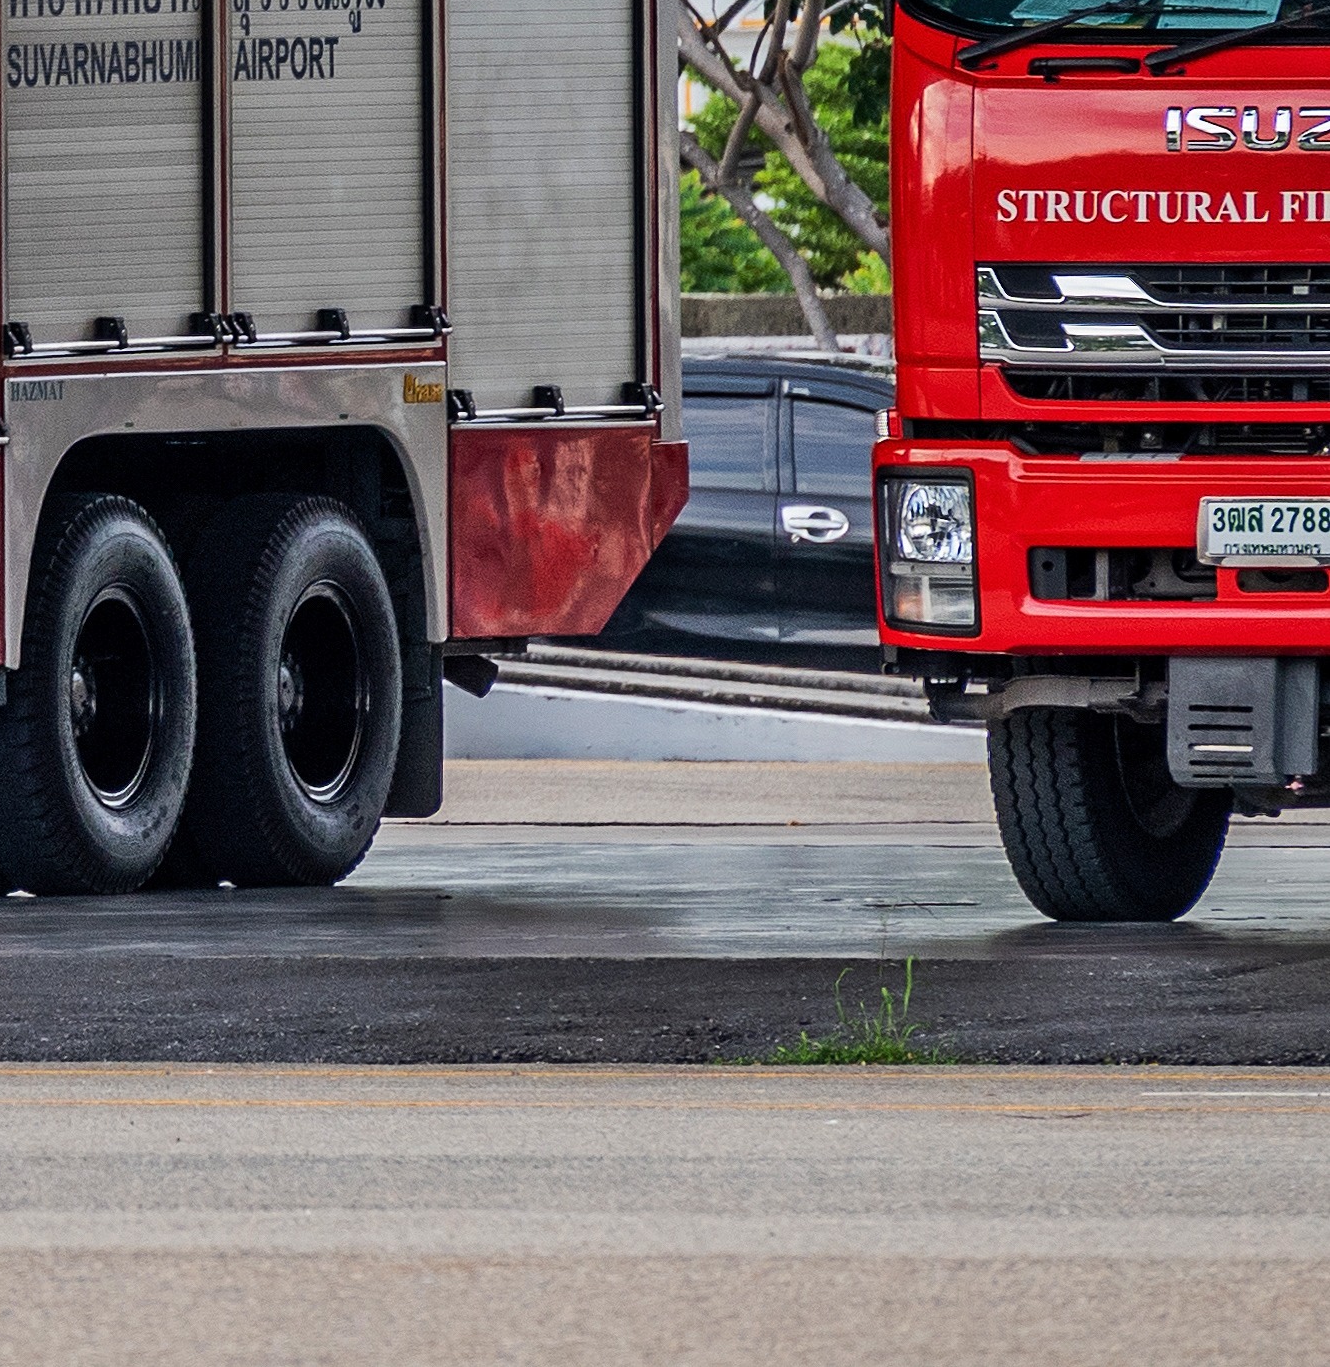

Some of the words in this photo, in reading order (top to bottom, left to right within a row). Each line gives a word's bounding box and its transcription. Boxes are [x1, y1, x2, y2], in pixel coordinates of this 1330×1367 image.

[6, 40, 201, 89] SUVARNABHUMI
[233, 35, 339, 83] AIRPORT
[996, 189, 1269, 224] STRUCTURAL
[10, 379, 64, 401] HAZMAT
[1271, 506, 1330, 533] 2788
[1224, 543, 1321, 555] กรงเทพมหานคร
